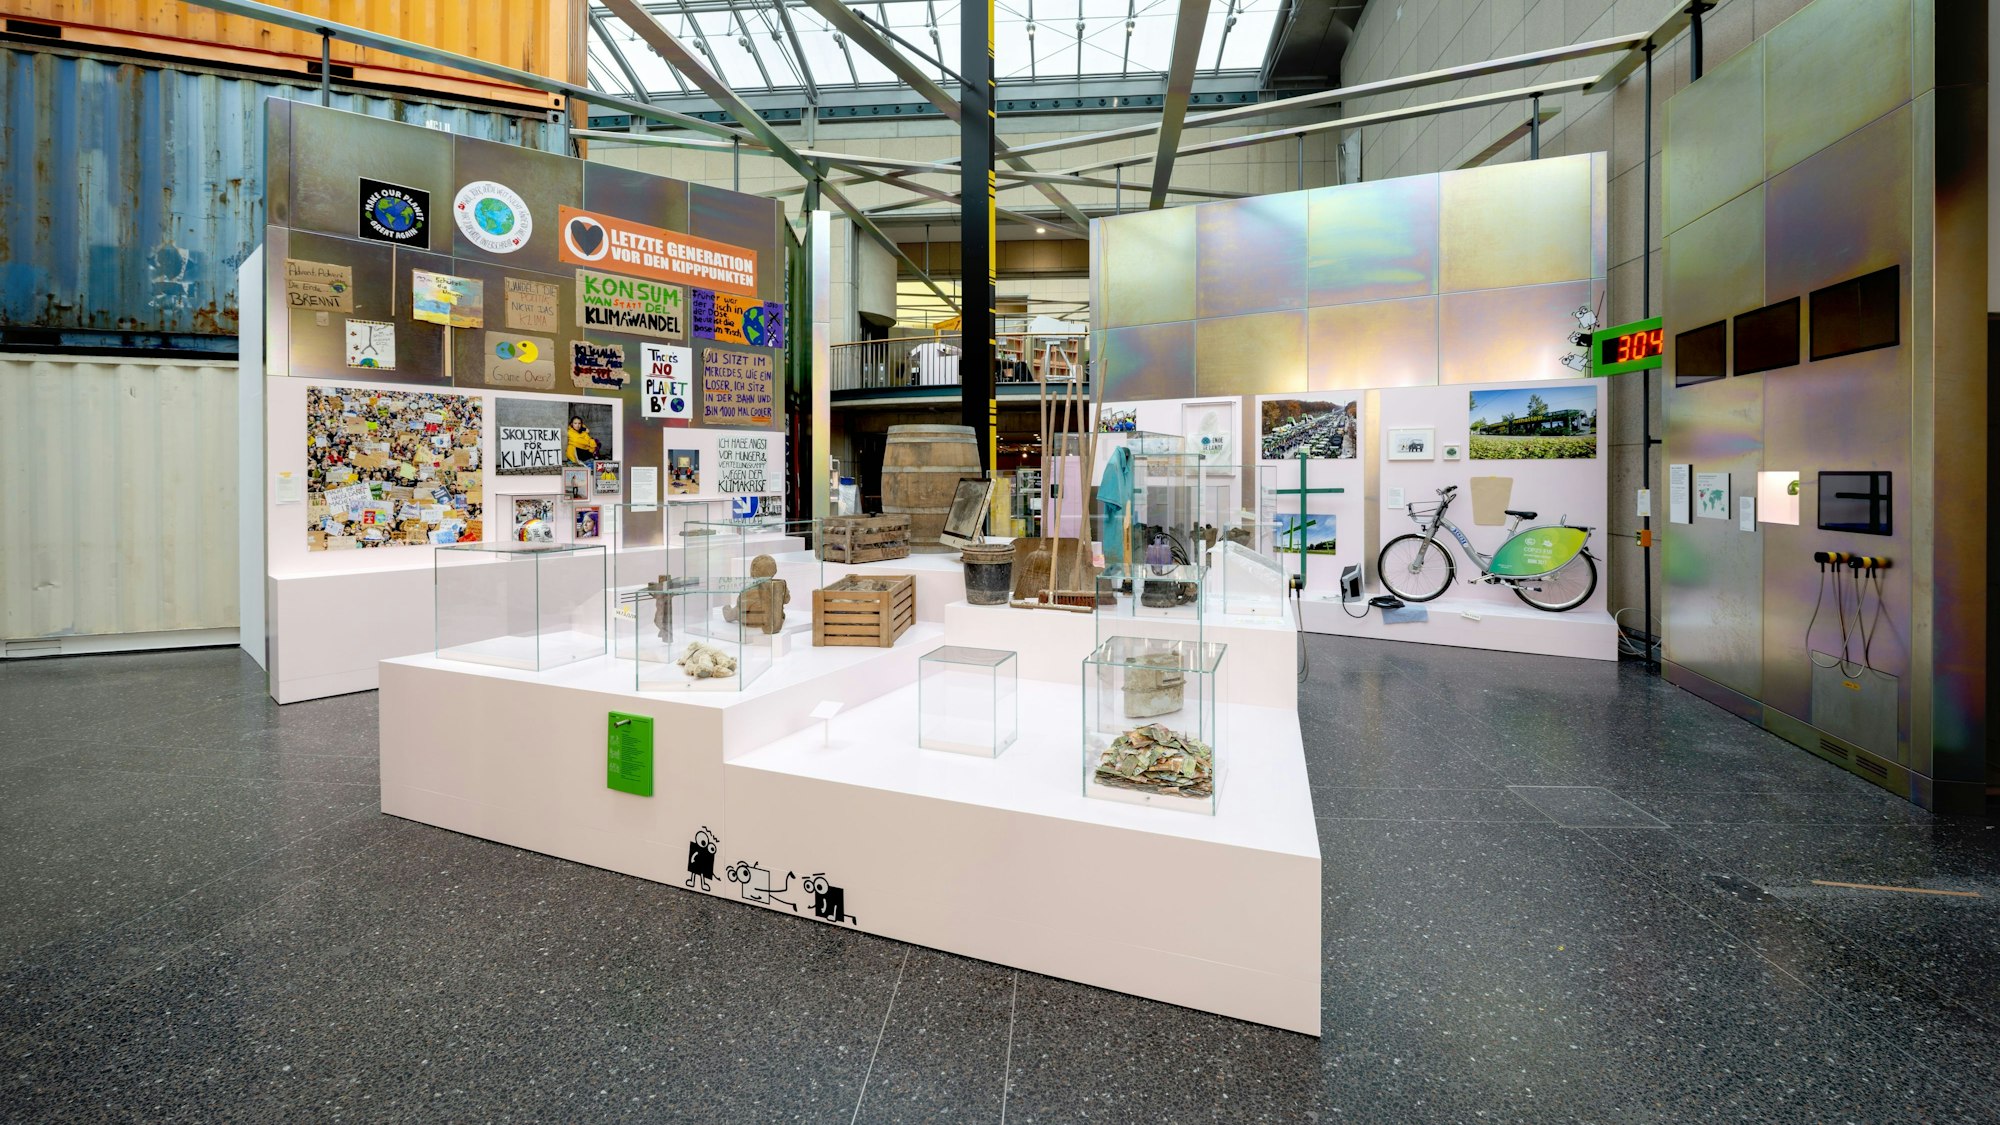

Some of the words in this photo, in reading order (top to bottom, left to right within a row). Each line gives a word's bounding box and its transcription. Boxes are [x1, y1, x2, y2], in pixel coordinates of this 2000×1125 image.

[365, 192, 381, 211] MAKE
[381, 189, 402, 198] OUR
[403, 194, 424, 221] PLANET
[370, 220, 394, 238] GREAT
[396, 227, 419, 239] AGAIN
[611, 229, 664, 254] LETZTE
[667, 242, 753, 273] GENERATION
[611, 246, 640, 264] VOR
[644, 253, 669, 270] DEN
[672, 259, 753, 286] KIPPPUNKTEN
[289, 292, 340, 307] BRENNT
[692, 290, 720, 301] Früher
[538, 306, 554, 316] DAS
[583, 295, 611, 307] WAN
[613, 299, 642, 309] STATT
[645, 303, 670, 314] DEL
[735, 306, 743, 315] in
[520, 314, 547, 327] KLIMA
[585, 306, 680, 333] KLIMAWANDEL
[1617, 329, 1664, 363] 304
[647, 348, 678, 363] There's
[706, 353, 717, 363] DU
[722, 353, 749, 365] SITZT
[754, 357, 765, 366] IM
[493, 366, 519, 381] Game
[525, 370, 552, 382] Over?
[652, 363, 672, 375] NO
[646, 379, 688, 396] PLANET
[734, 381, 745, 391] ICH
[705, 393, 713, 402] IN
[716, 394, 732, 402] DER
[736, 394, 755, 403] BAHN
[757, 395, 771, 403] UND
[705, 405, 718, 416] BIN
[720, 406, 735, 417] 1000
[738, 406, 749, 416] MAL
[751, 407, 772, 417] COOLER
[501, 428, 560, 441] SKOLSTREJK
[524, 440, 542, 450] FÖR
[719, 438, 730, 449] ICH
[731, 438, 749, 449] HABE
[749, 438, 767, 450] ANGST
[501, 449, 561, 468] KLIMATET
[719, 450, 733, 459] VOR
[735, 451, 760, 461] HUNGER
[722, 469, 747, 480] WEGEN
[748, 469, 764, 480] DER
[718, 479, 767, 493] KLIMAKRISE
